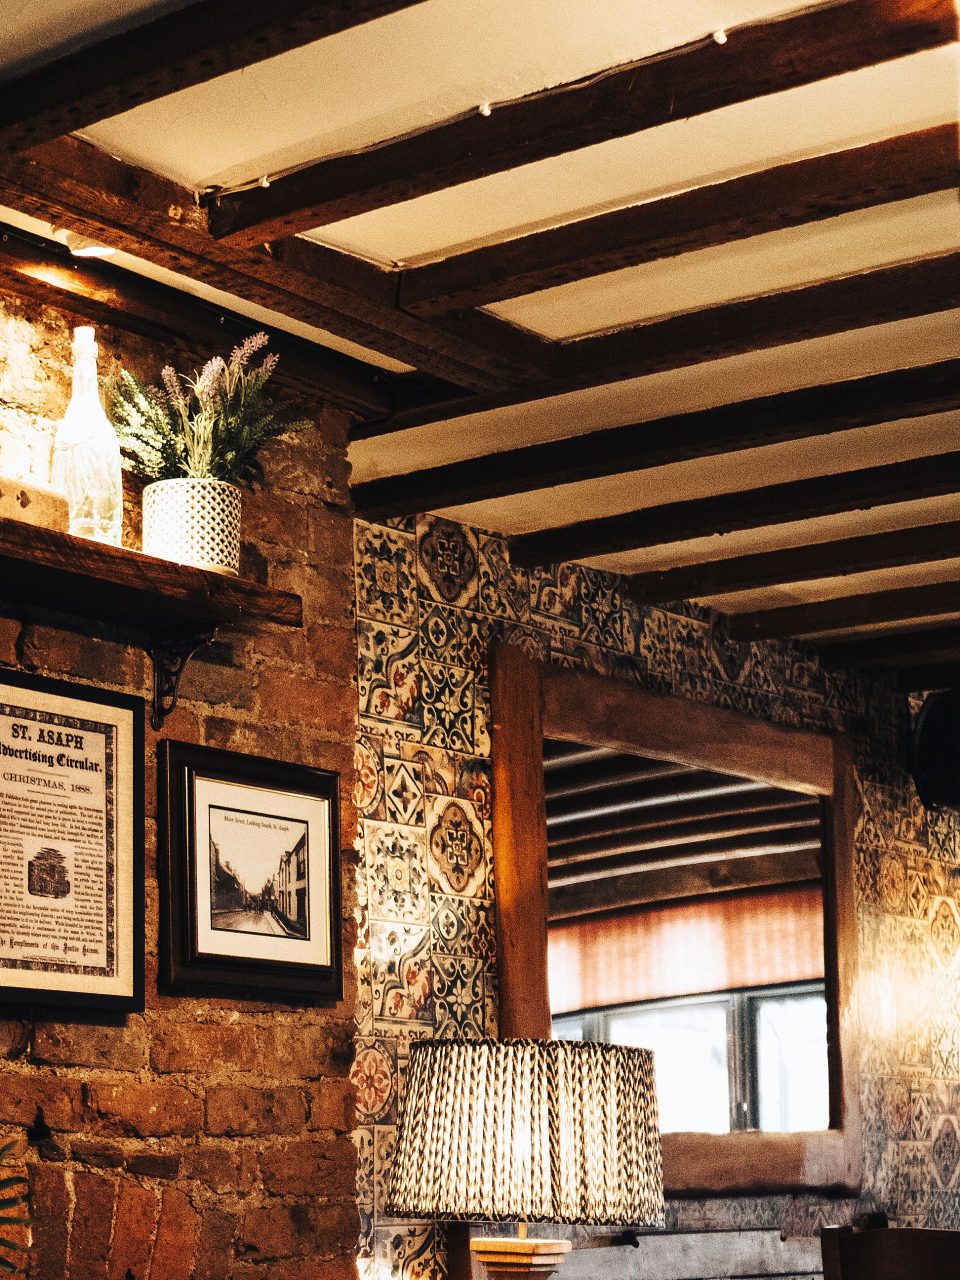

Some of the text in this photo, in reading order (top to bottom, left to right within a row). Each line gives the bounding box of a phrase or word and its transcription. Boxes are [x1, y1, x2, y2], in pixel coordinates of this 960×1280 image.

[11, 723, 85, 751] ST. ASAPH
[56, 753, 103, 773] Circular.
[2, 772, 67, 791] CHRISTMAS,
